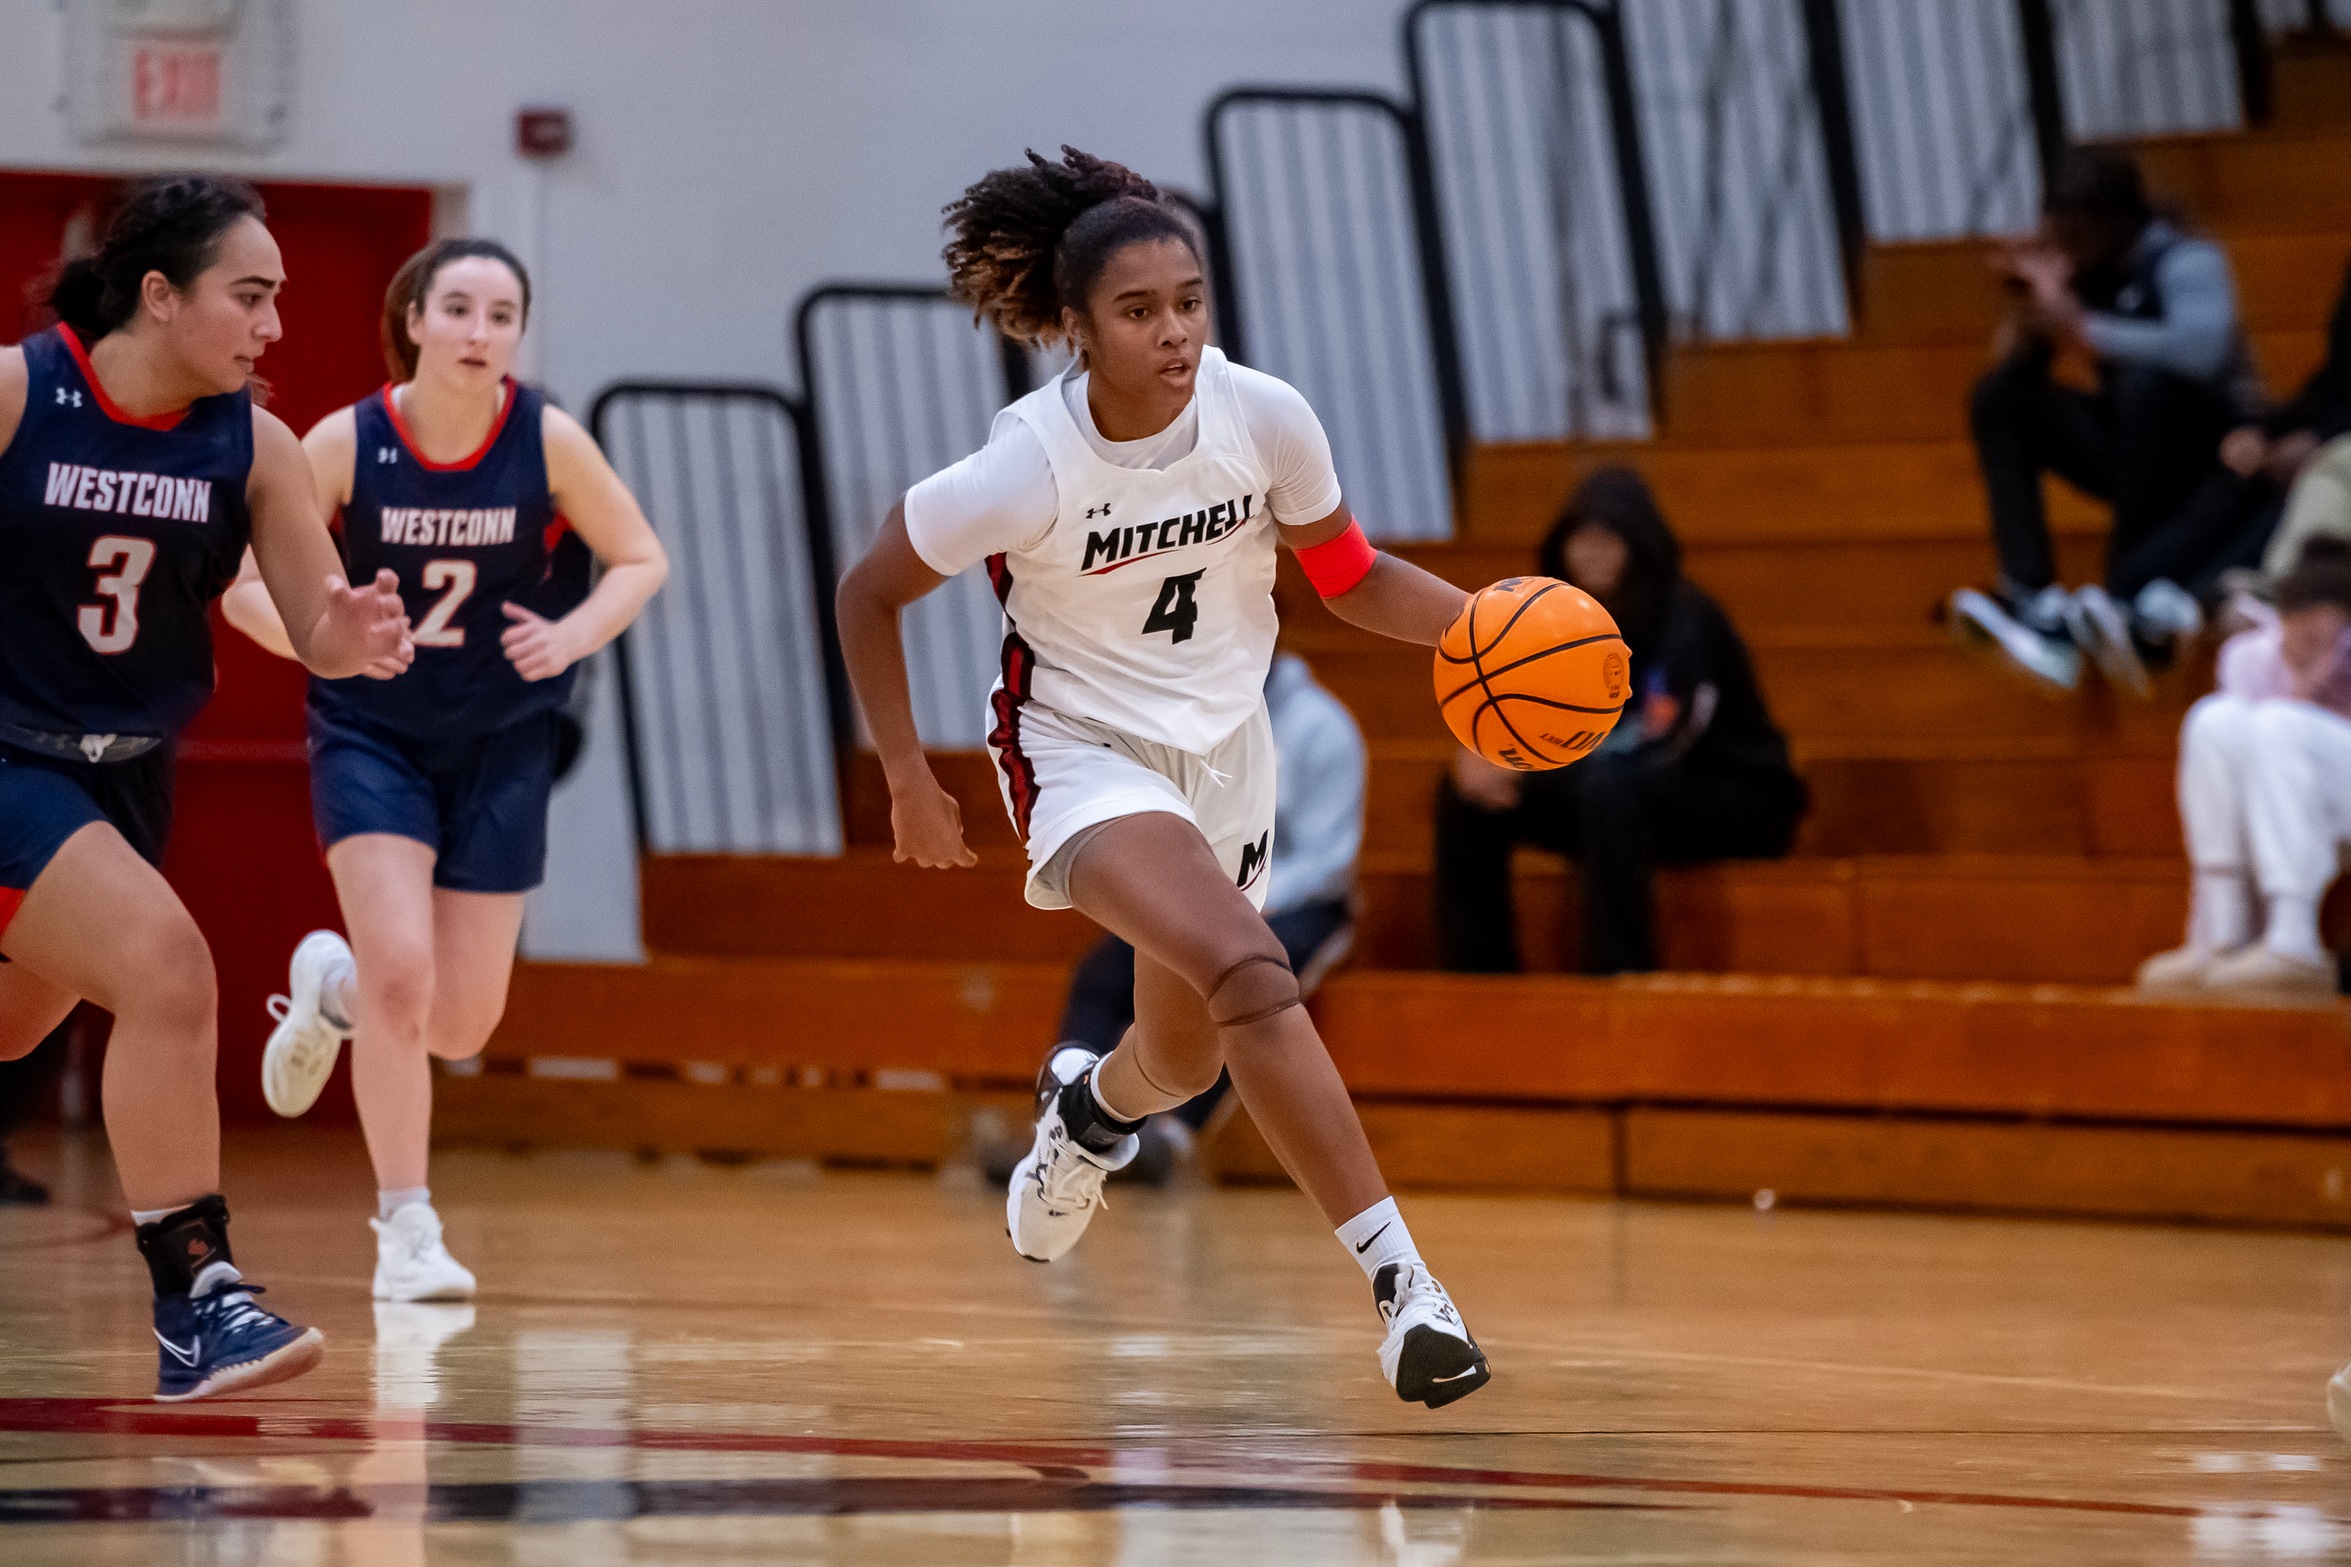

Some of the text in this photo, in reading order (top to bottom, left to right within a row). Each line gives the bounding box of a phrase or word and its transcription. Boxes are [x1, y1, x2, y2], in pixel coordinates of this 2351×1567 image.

[44, 461, 211, 523] WESTCONN
[380, 506, 517, 546] WESTCONN
[77, 534, 157, 655] 3
[411, 558, 478, 647] 2
[1141, 567, 1207, 645] 4
[1237, 828, 1269, 889] M
